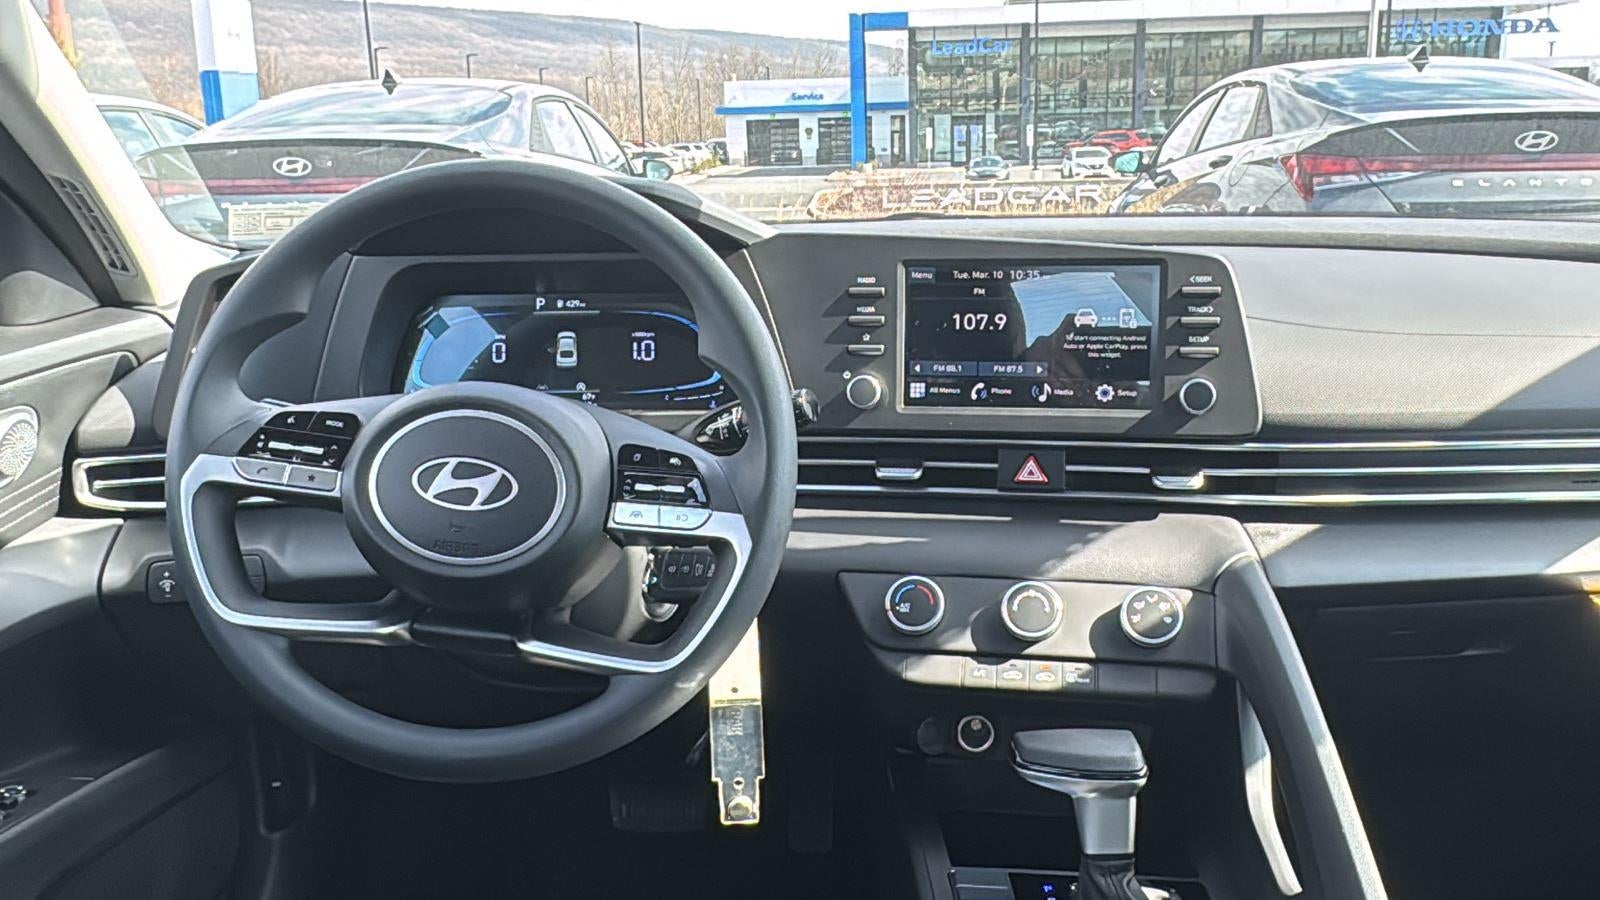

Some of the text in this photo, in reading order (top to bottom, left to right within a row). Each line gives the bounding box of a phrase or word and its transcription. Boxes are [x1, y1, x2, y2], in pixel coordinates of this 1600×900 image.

[1431, 18, 1560, 37] HONDA
[931, 36, 1012, 56] LeadCar
[791, 91, 824, 101] Service
[882, 184, 1102, 209] LEADCAR
[857, 276, 876, 284] RADIO
[911, 271, 933, 279] Menu
[953, 270, 970, 279] Tue.
[972, 271, 990, 279] Mar.
[993, 271, 1004, 279] 10
[1010, 270, 1040, 280] 10:35
[1195, 275, 1212, 283] SEEK
[973, 287, 986, 296] FM
[536, 297, 546, 310] P
[952, 313, 1008, 331] 107.9
[492, 342, 507, 364] 0
[632, 340, 656, 361] 1.0
[993, 365, 1024, 373] FM 87.5
[991, 387, 1012, 395] Phone
[1053, 388, 1074, 396] Media
[1117, 388, 1138, 397] Setup
